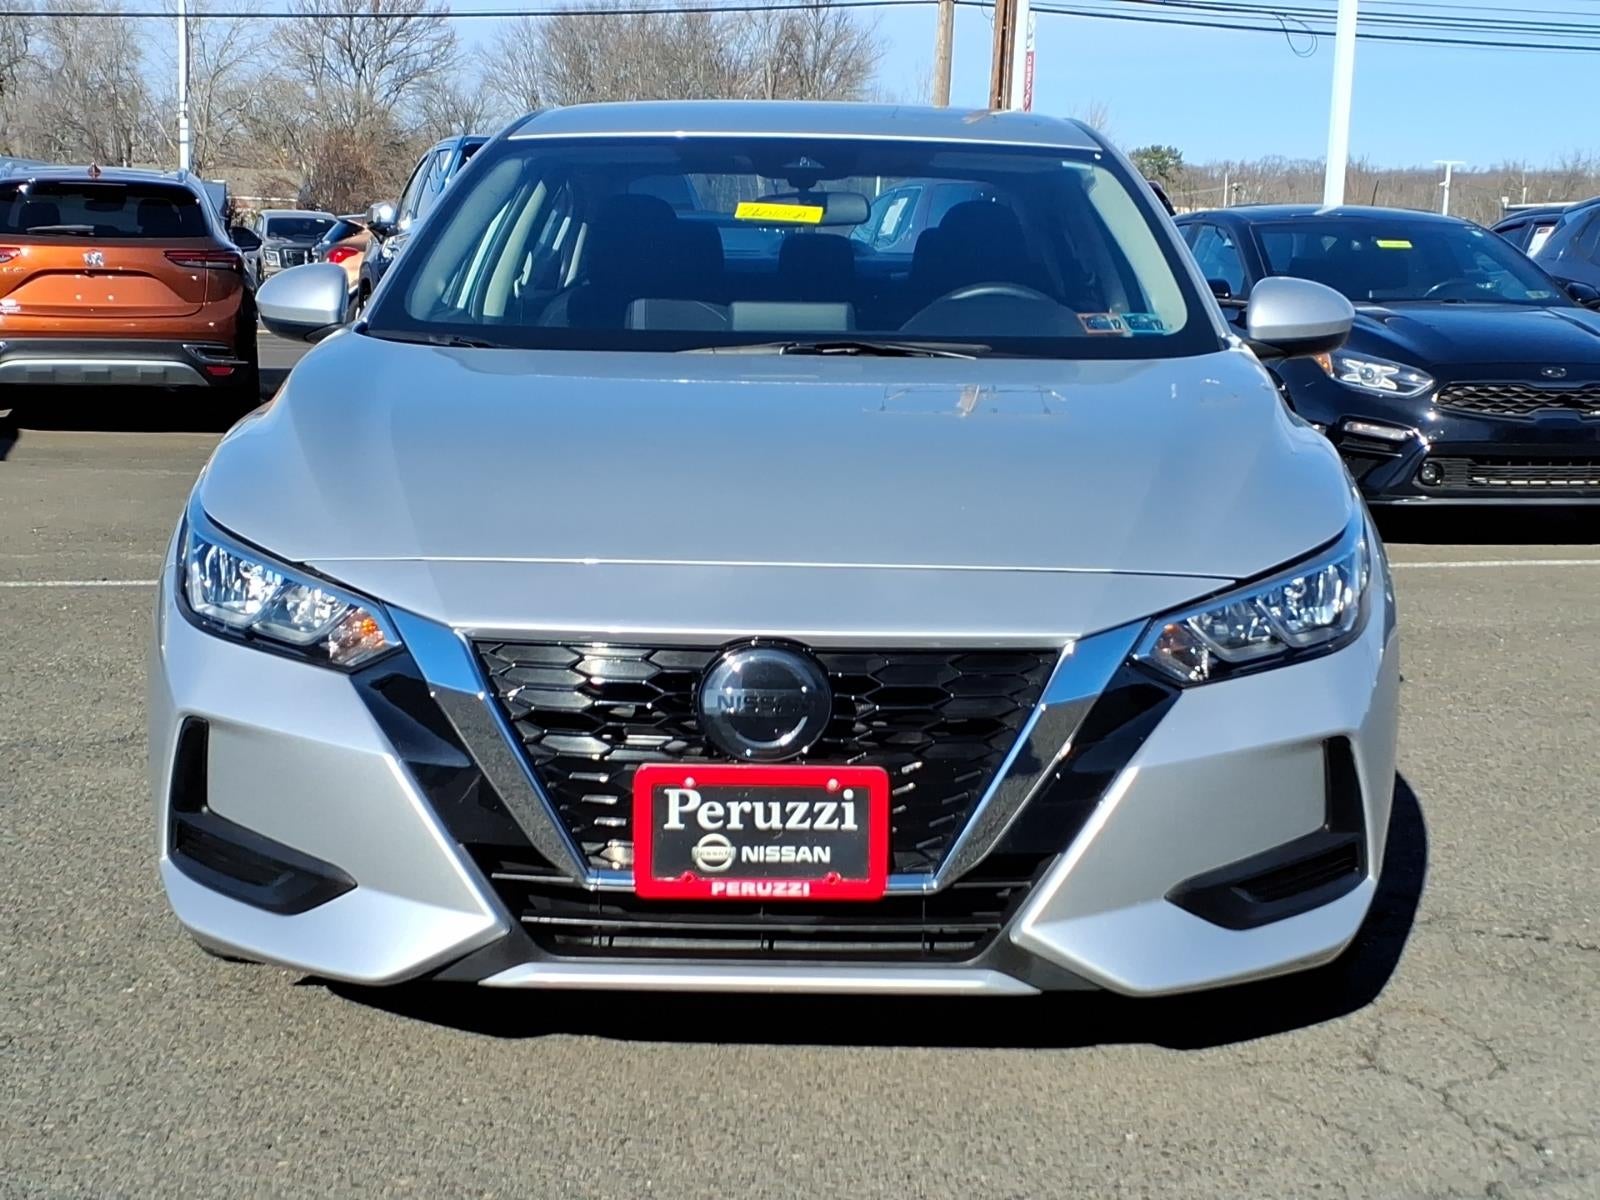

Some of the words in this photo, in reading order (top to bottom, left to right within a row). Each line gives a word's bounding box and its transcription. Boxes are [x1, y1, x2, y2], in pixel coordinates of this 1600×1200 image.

[663, 788, 858, 831] Peruzzi
[741, 846, 831, 863] NISSAN
[711, 881, 811, 897] PERUZZI
